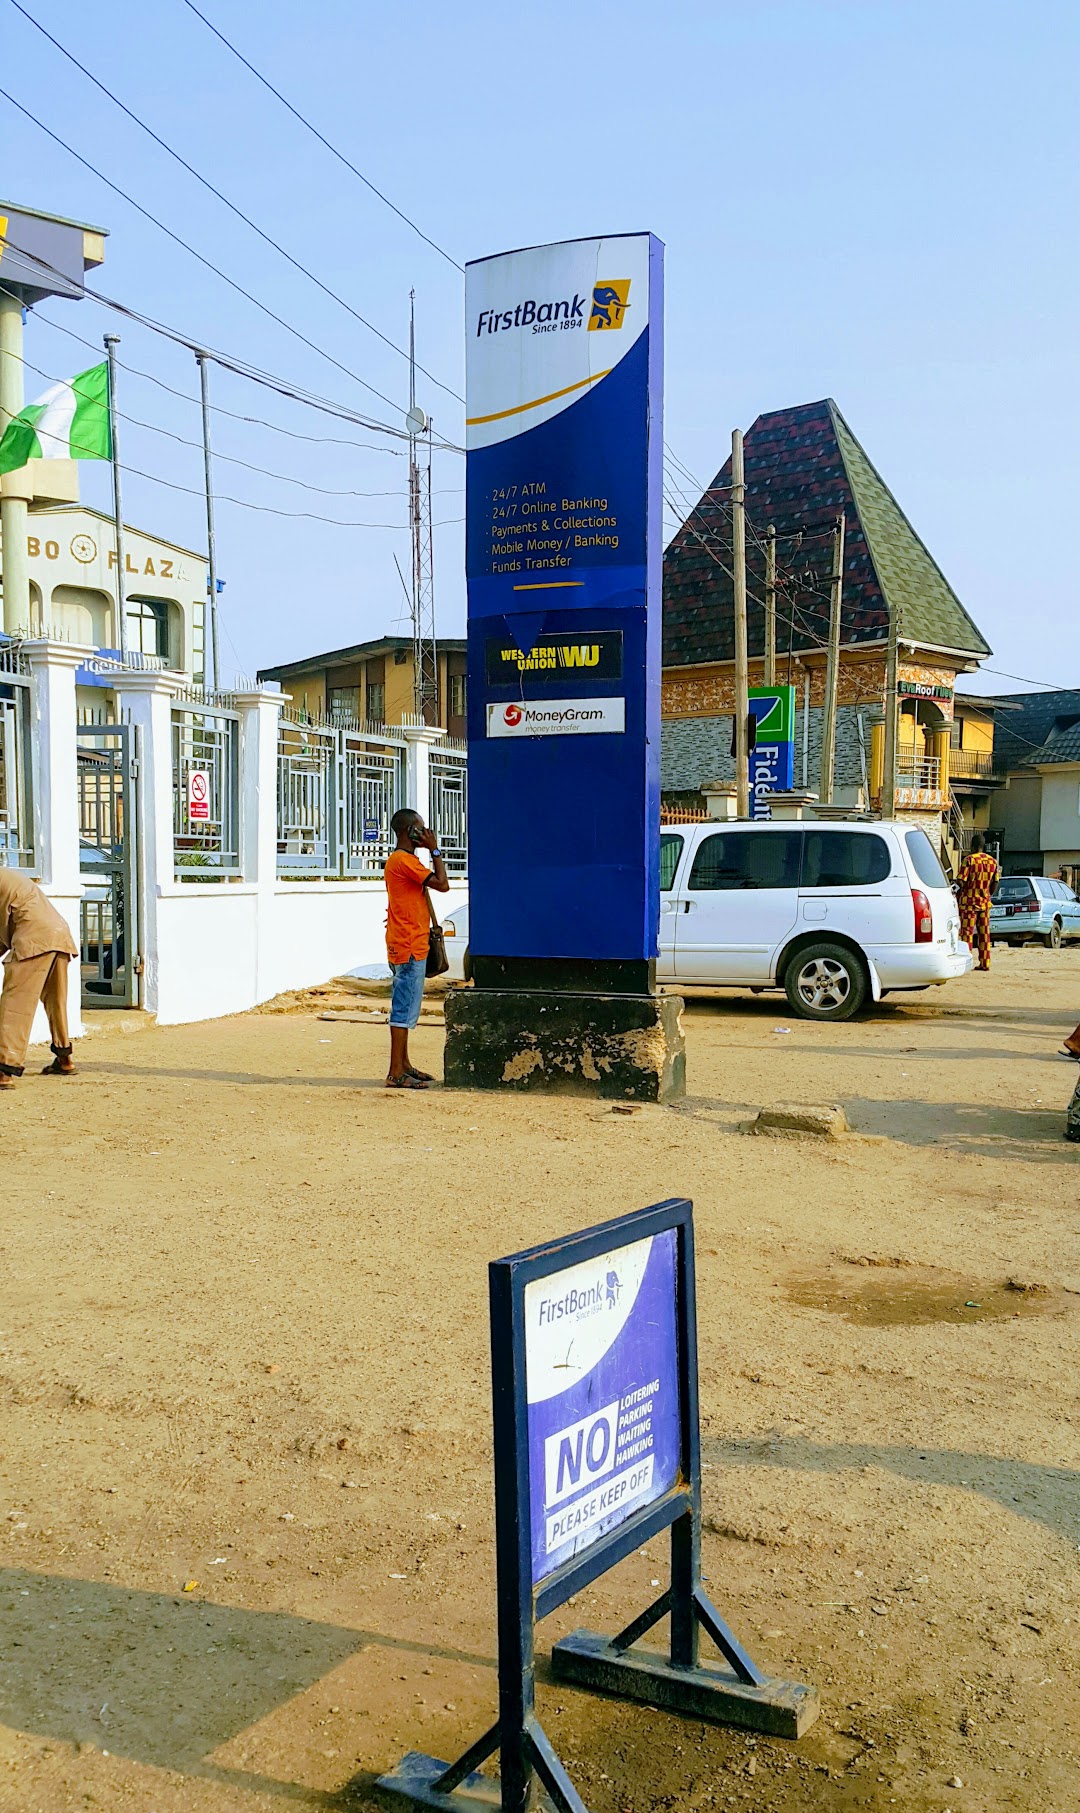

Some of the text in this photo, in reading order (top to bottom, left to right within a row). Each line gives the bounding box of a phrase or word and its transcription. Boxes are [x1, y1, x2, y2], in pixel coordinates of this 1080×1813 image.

[476, 294, 587, 337] FirstBank
[532, 319, 583, 335] Since 1894
[492, 482, 546, 501] 24/7 ATM
[492, 497, 608, 519] 24/7 Online Banking
[491, 516, 617, 539] Payments & Collections
[491, 541, 523, 556] Mobile
[527, 538, 563, 552] Money
[574, 534, 619, 548] Banking
[492, 555, 573, 573] Funds Transfer
[501, 647, 556, 661] WESERN
[517, 657, 557, 671] UNION
[563, 645, 600, 667] WU
[525, 708, 604, 724] MoneyGram
[525, 723, 580, 734] money transfer
[539, 1280, 604, 1326] FirstBank
[620, 1378, 660, 1411] LOITERING
[618, 1400, 653, 1429] PARKING
[617, 1418, 651, 1448] WAITING
[556, 1417, 610, 1494] NO
[615, 1434, 653, 1467] HAWKING
[552, 1466, 649, 1541] PLEASE KEEP OFF
